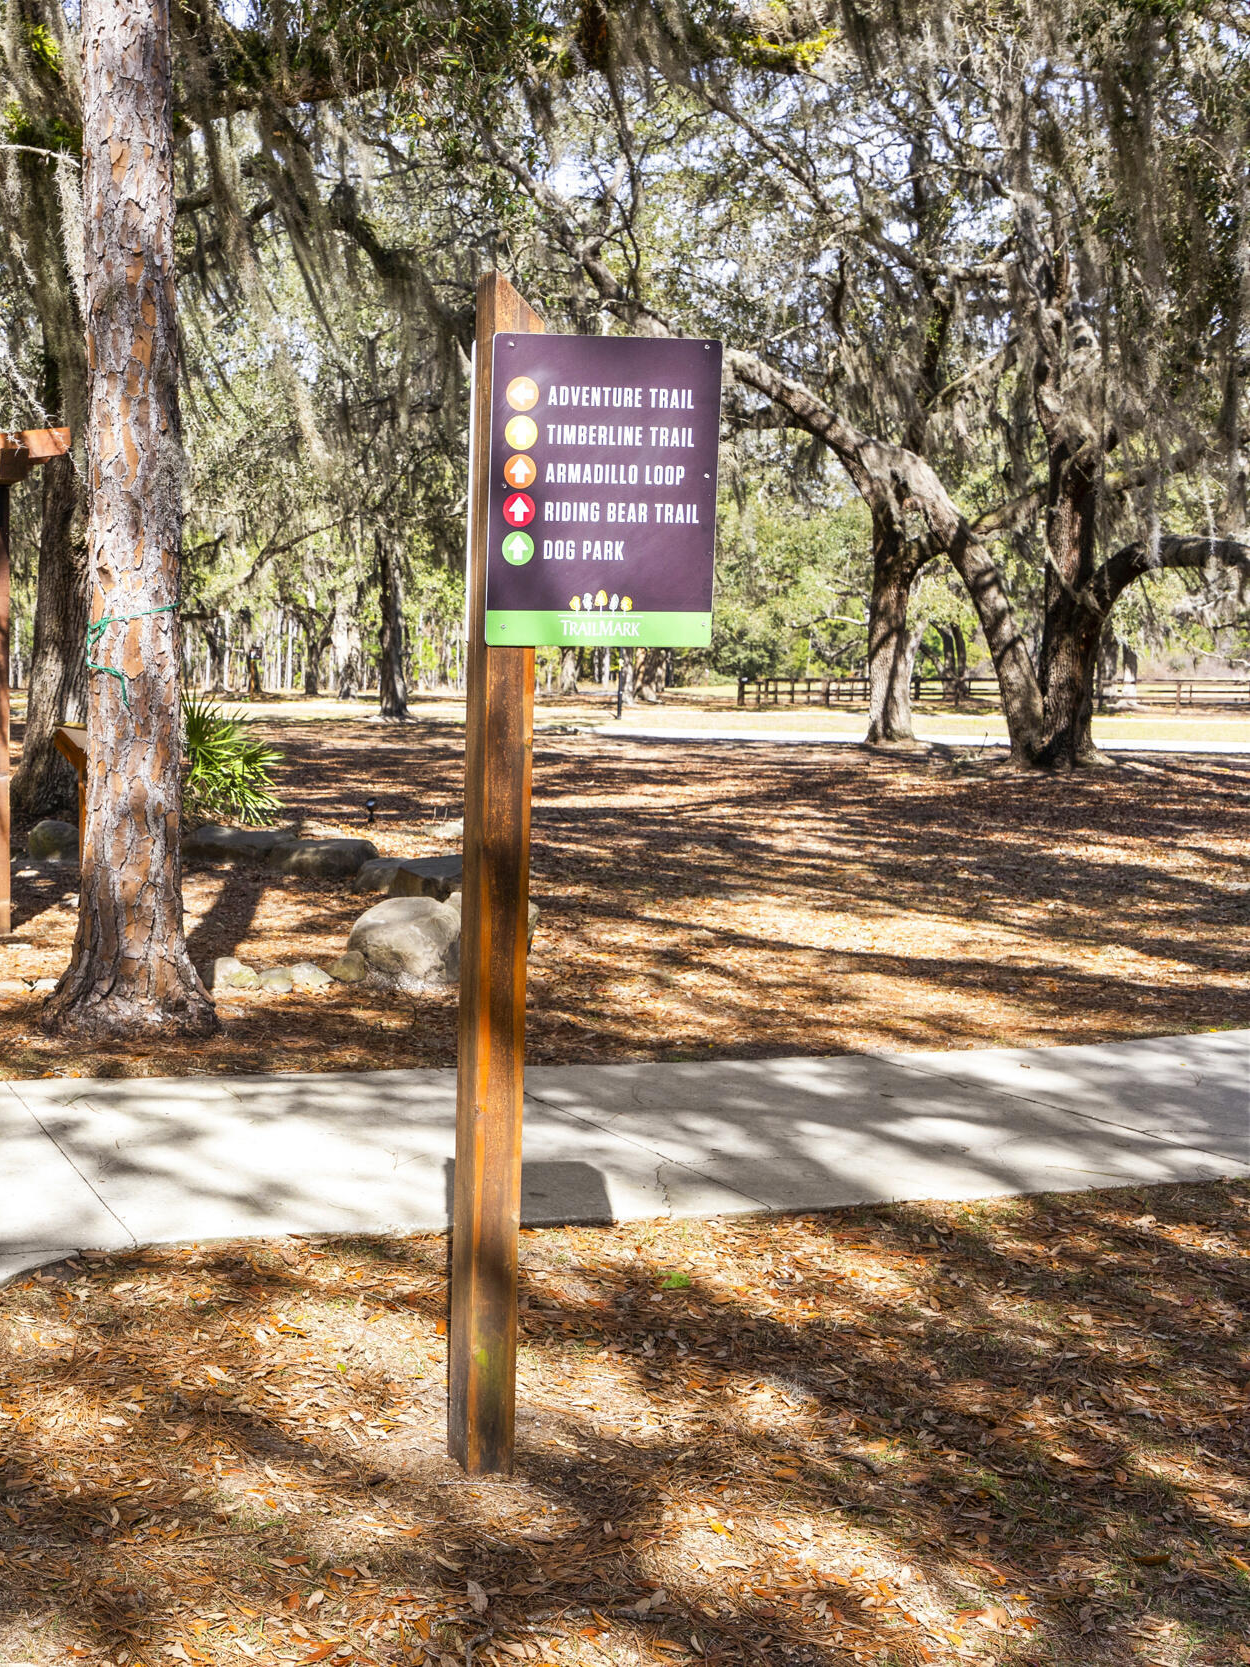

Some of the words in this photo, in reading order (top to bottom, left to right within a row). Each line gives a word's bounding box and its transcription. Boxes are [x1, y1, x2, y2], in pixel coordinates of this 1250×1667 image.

[547, 385, 643, 408] ADVENTURE
[649, 388, 694, 409] TRAIL
[546, 424, 643, 447] TIMBERLINE
[649, 427, 694, 448] TRAIL
[545, 463, 638, 484] ARMADILLO
[644, 465, 686, 486] LOOP
[544, 502, 601, 522] RIDING
[607, 503, 648, 523] BEAR
[654, 504, 700, 524] TRAIL
[543, 540, 576, 560] DOG
[582, 540, 625, 561] PARK
